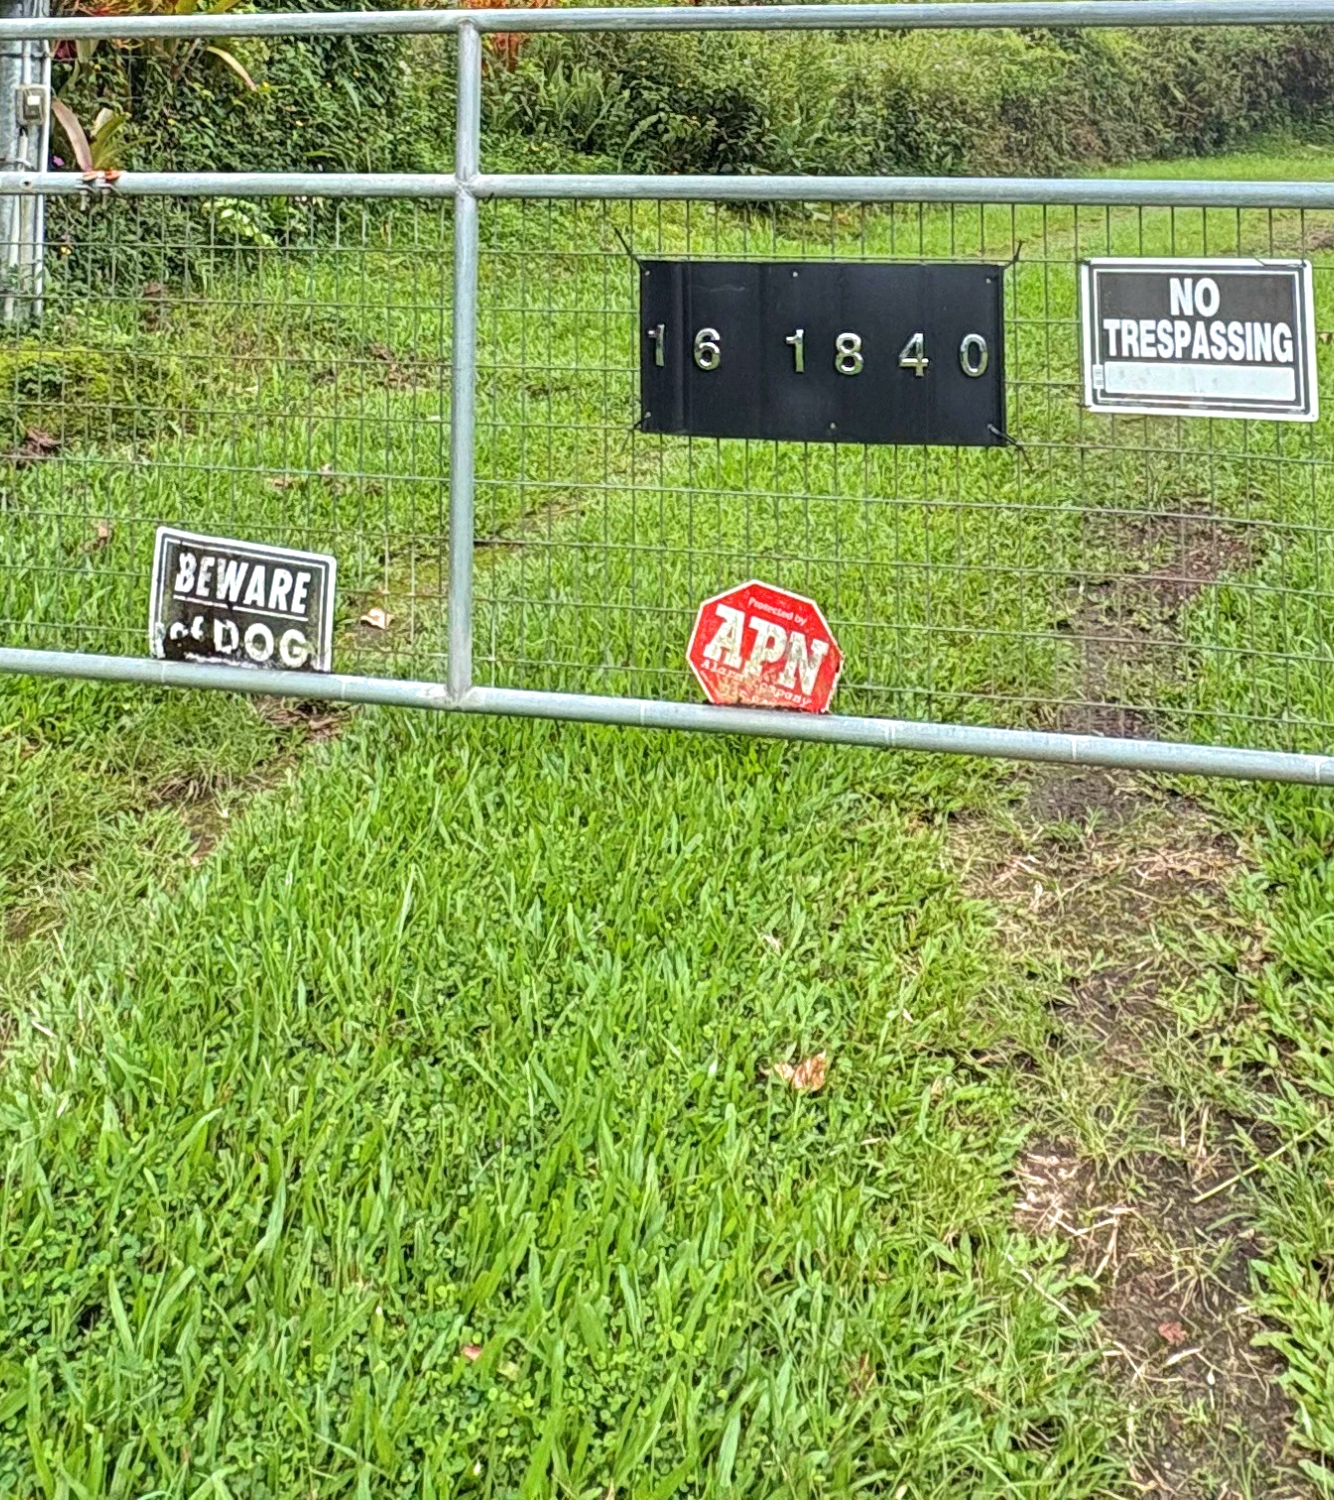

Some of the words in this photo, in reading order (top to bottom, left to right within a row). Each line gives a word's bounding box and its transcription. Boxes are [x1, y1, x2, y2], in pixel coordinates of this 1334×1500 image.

[1169, 277, 1220, 317] NO
[648, 324, 721, 371] 16
[785, 328, 989, 378] 1840
[1103, 318, 1294, 363] TRESPASSING
[174, 552, 311, 614] BEWARE
[213, 617, 309, 668] DOG
[702, 603, 830, 696] APN
